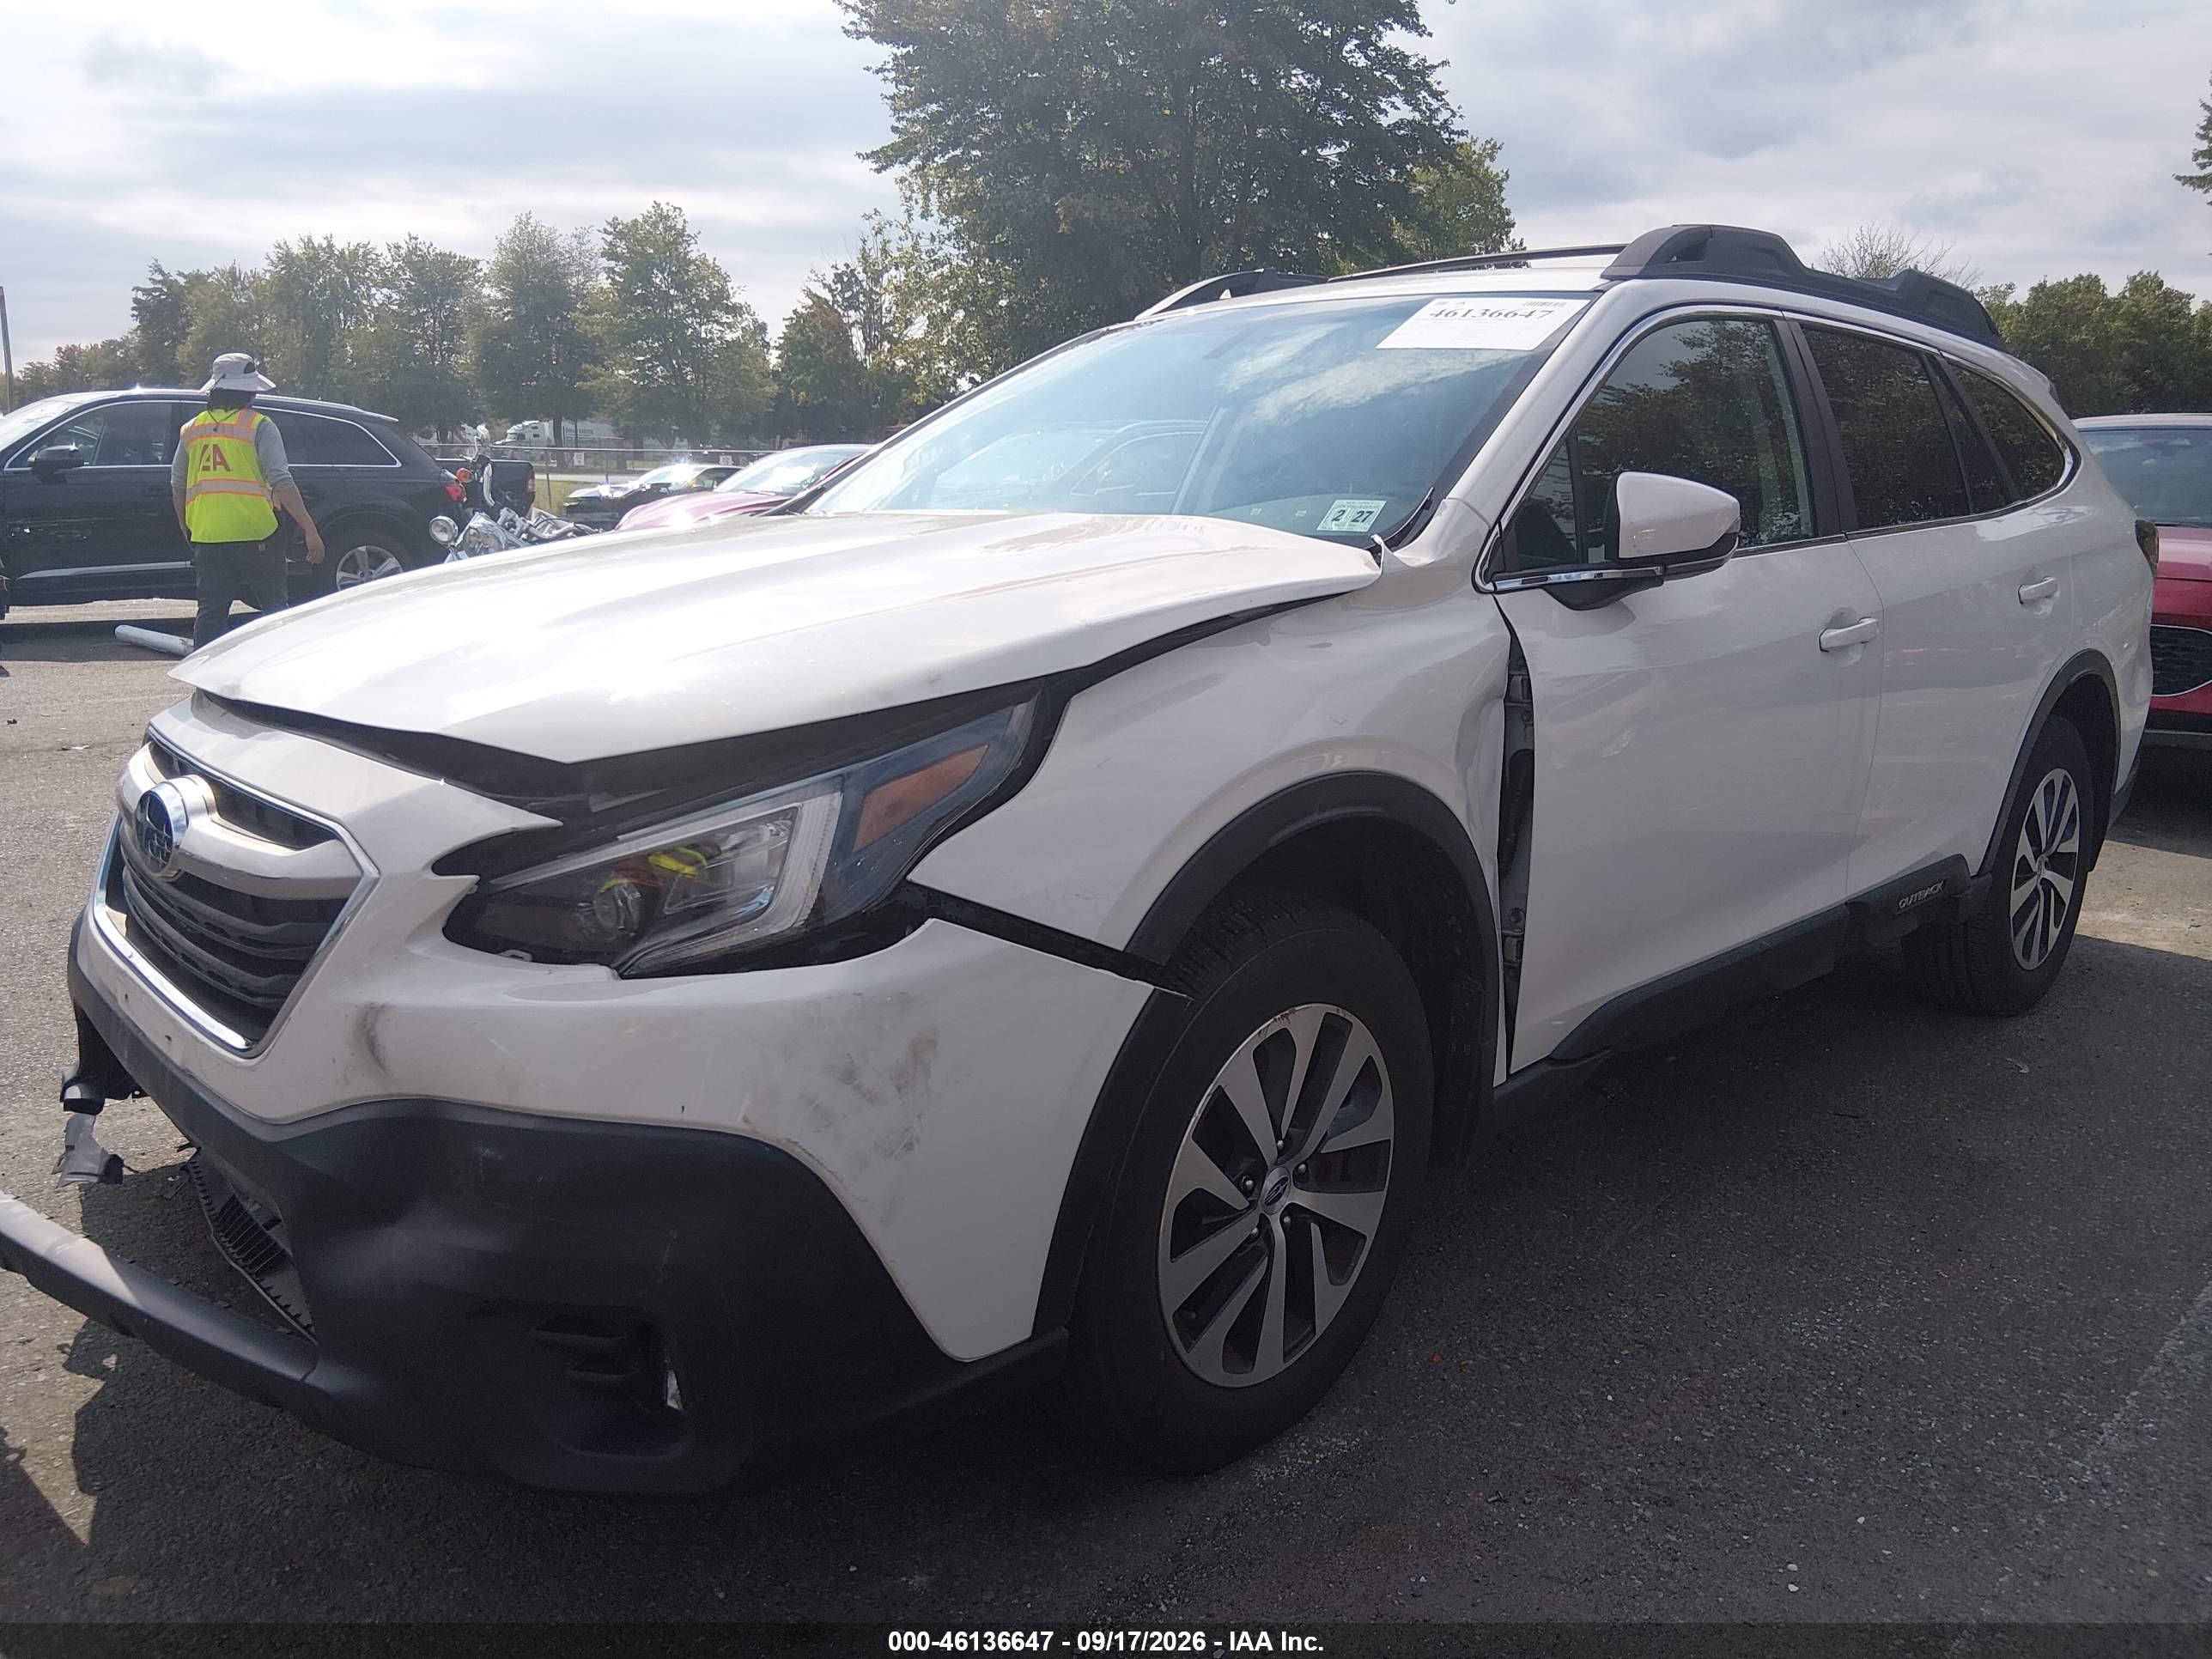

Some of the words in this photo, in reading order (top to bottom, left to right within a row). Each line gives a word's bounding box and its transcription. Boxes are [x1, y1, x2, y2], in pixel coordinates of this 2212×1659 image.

[1430, 308, 1554, 319] 46136647
[1332, 509, 1346, 521] 2
[1351, 511, 1374, 523] 27
